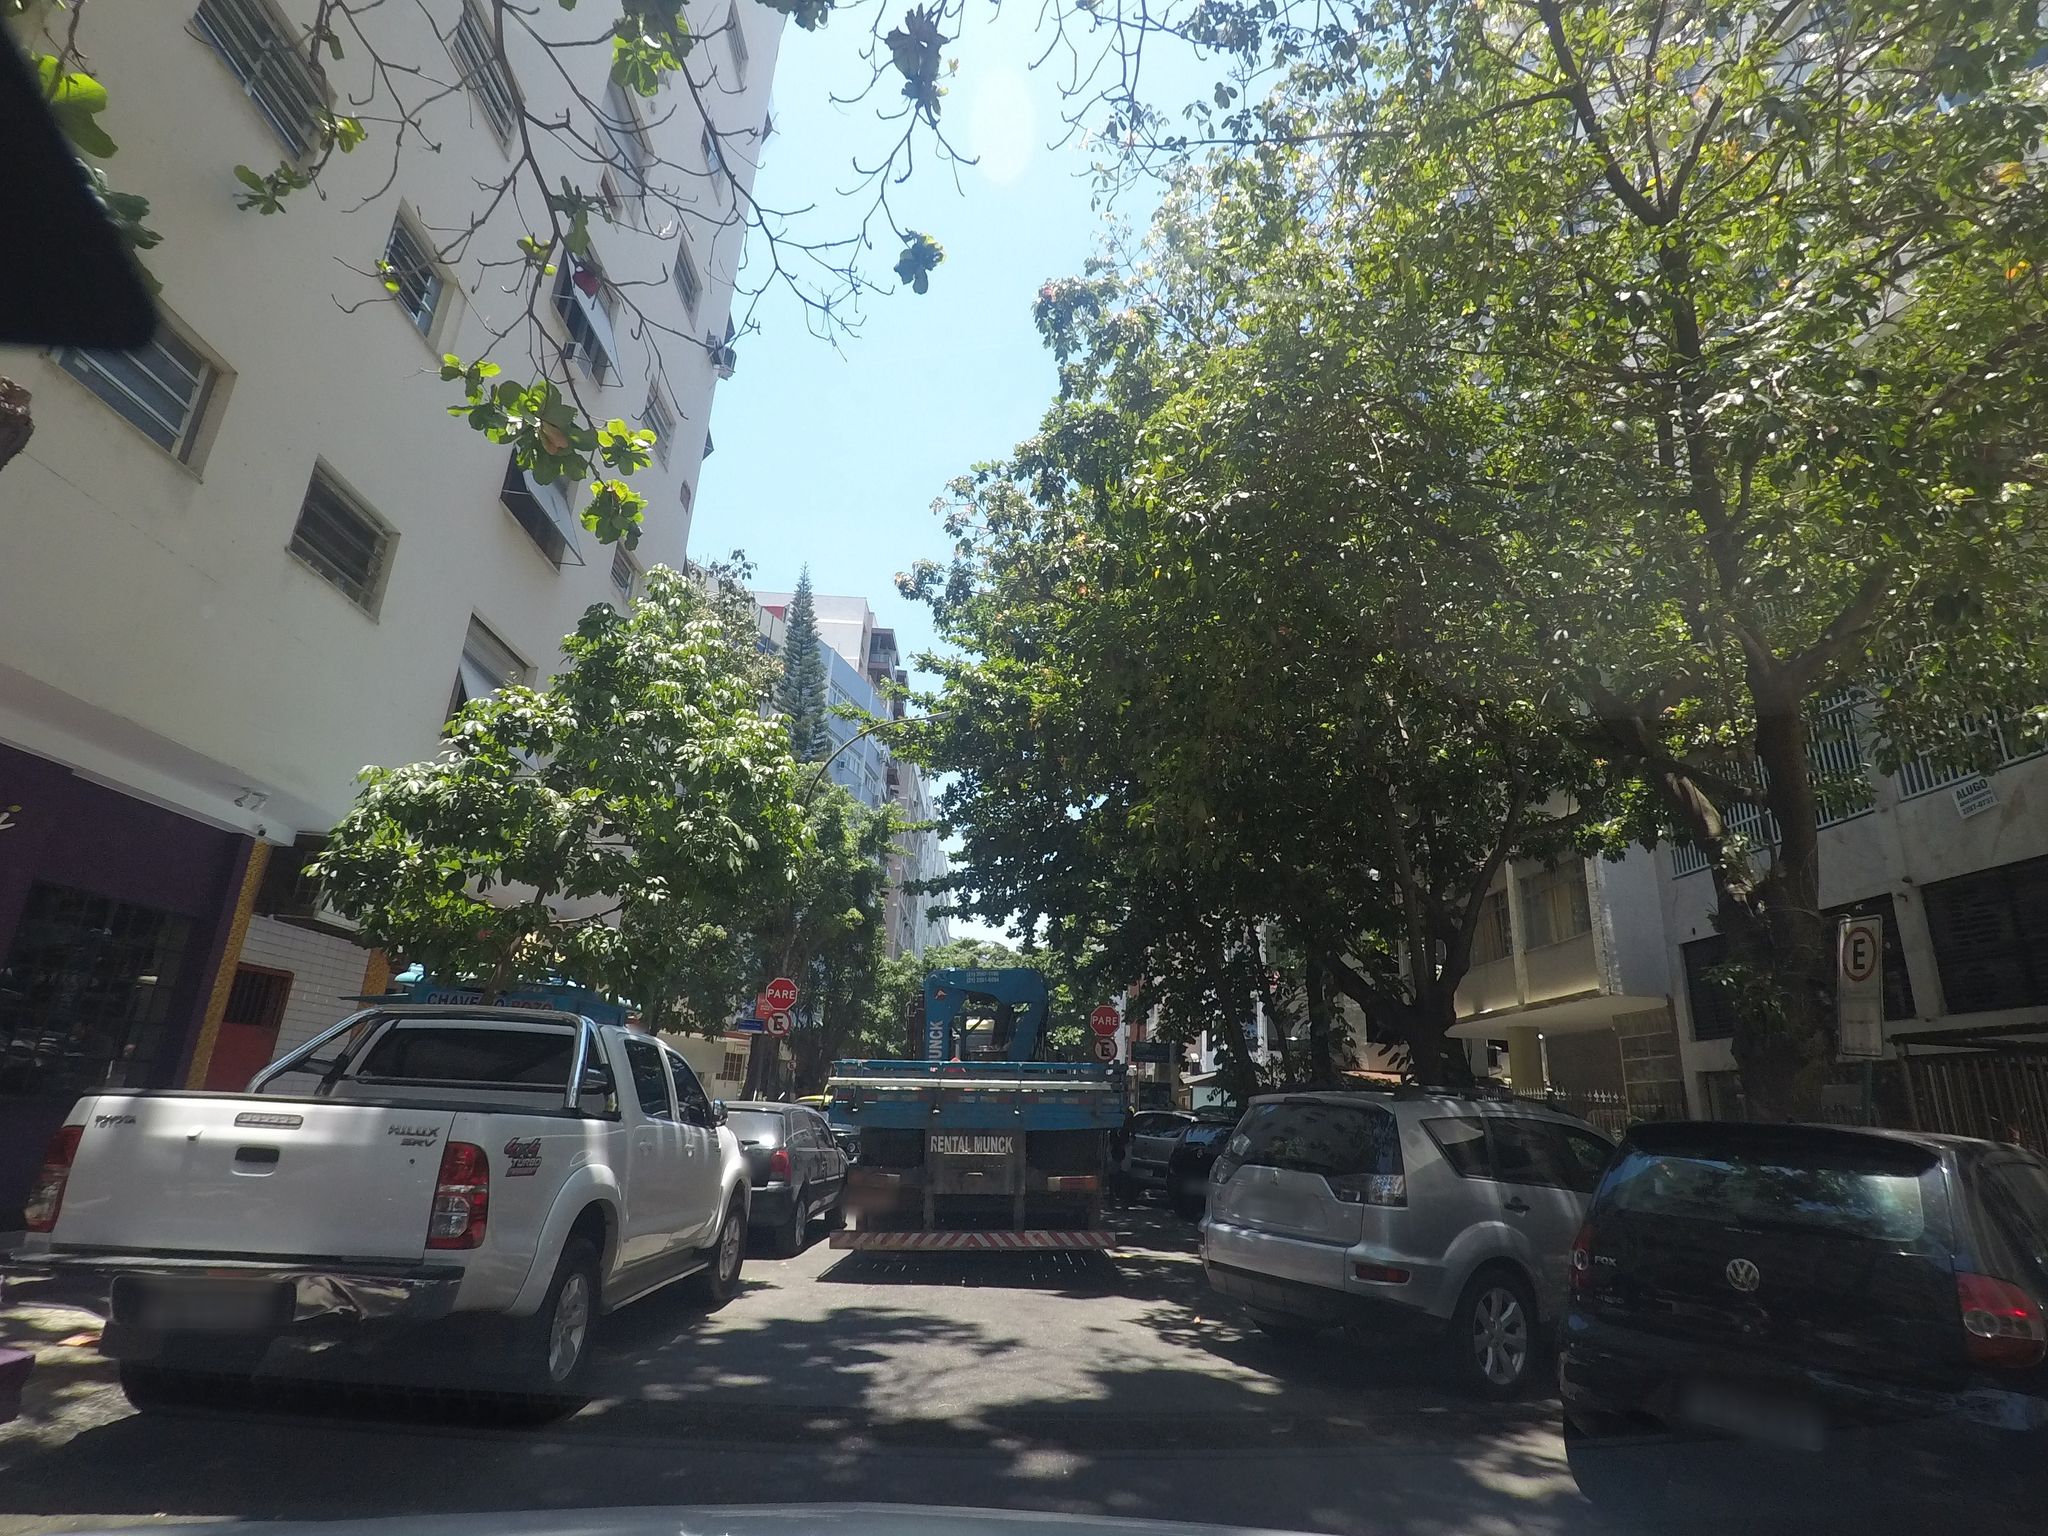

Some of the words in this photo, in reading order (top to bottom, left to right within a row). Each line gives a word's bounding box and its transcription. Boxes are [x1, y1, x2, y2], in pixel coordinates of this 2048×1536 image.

[1956, 779, 1988, 800] ALUGO
[1853, 939, 1865, 969] E
[427, 991, 505, 1008] CHAVEO
[768, 989, 796, 999] PARE
[773, 1015, 784, 1031] E
[1092, 1016, 1118, 1026] PARE
[928, 1020, 944, 1060] UNCK
[1101, 1042, 1111, 1057] E
[388, 1125, 440, 1137] HILUX
[930, 1135, 971, 1152] RENTAL
[974, 1135, 1014, 1153] MUNCK
[511, 1156, 543, 1168] TURBO
[1594, 1255, 1618, 1267] FOX
